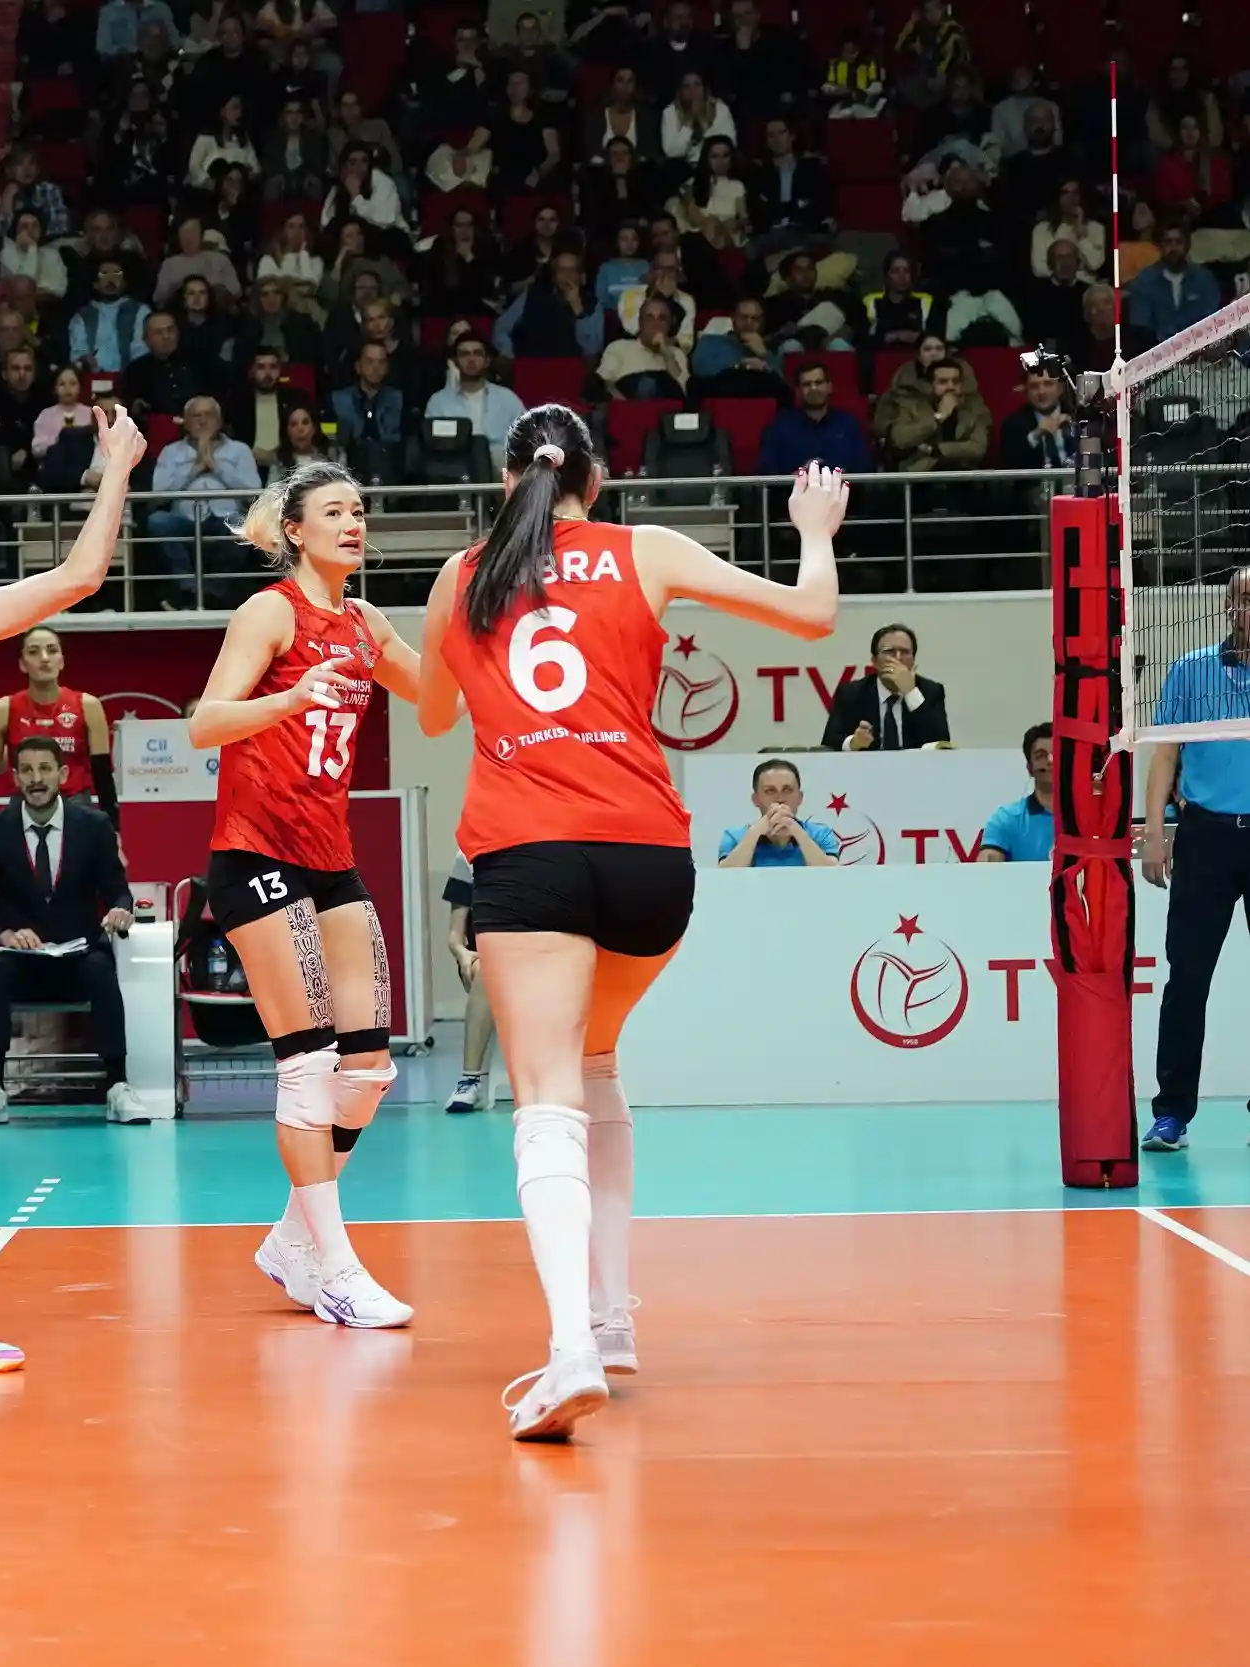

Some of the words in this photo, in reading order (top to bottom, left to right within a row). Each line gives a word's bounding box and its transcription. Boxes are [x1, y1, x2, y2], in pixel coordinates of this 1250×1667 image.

[509, 606, 588, 713] 6
[756, 665, 879, 722] TV
[305, 709, 357, 780] 13
[248, 870, 288, 904] 13
